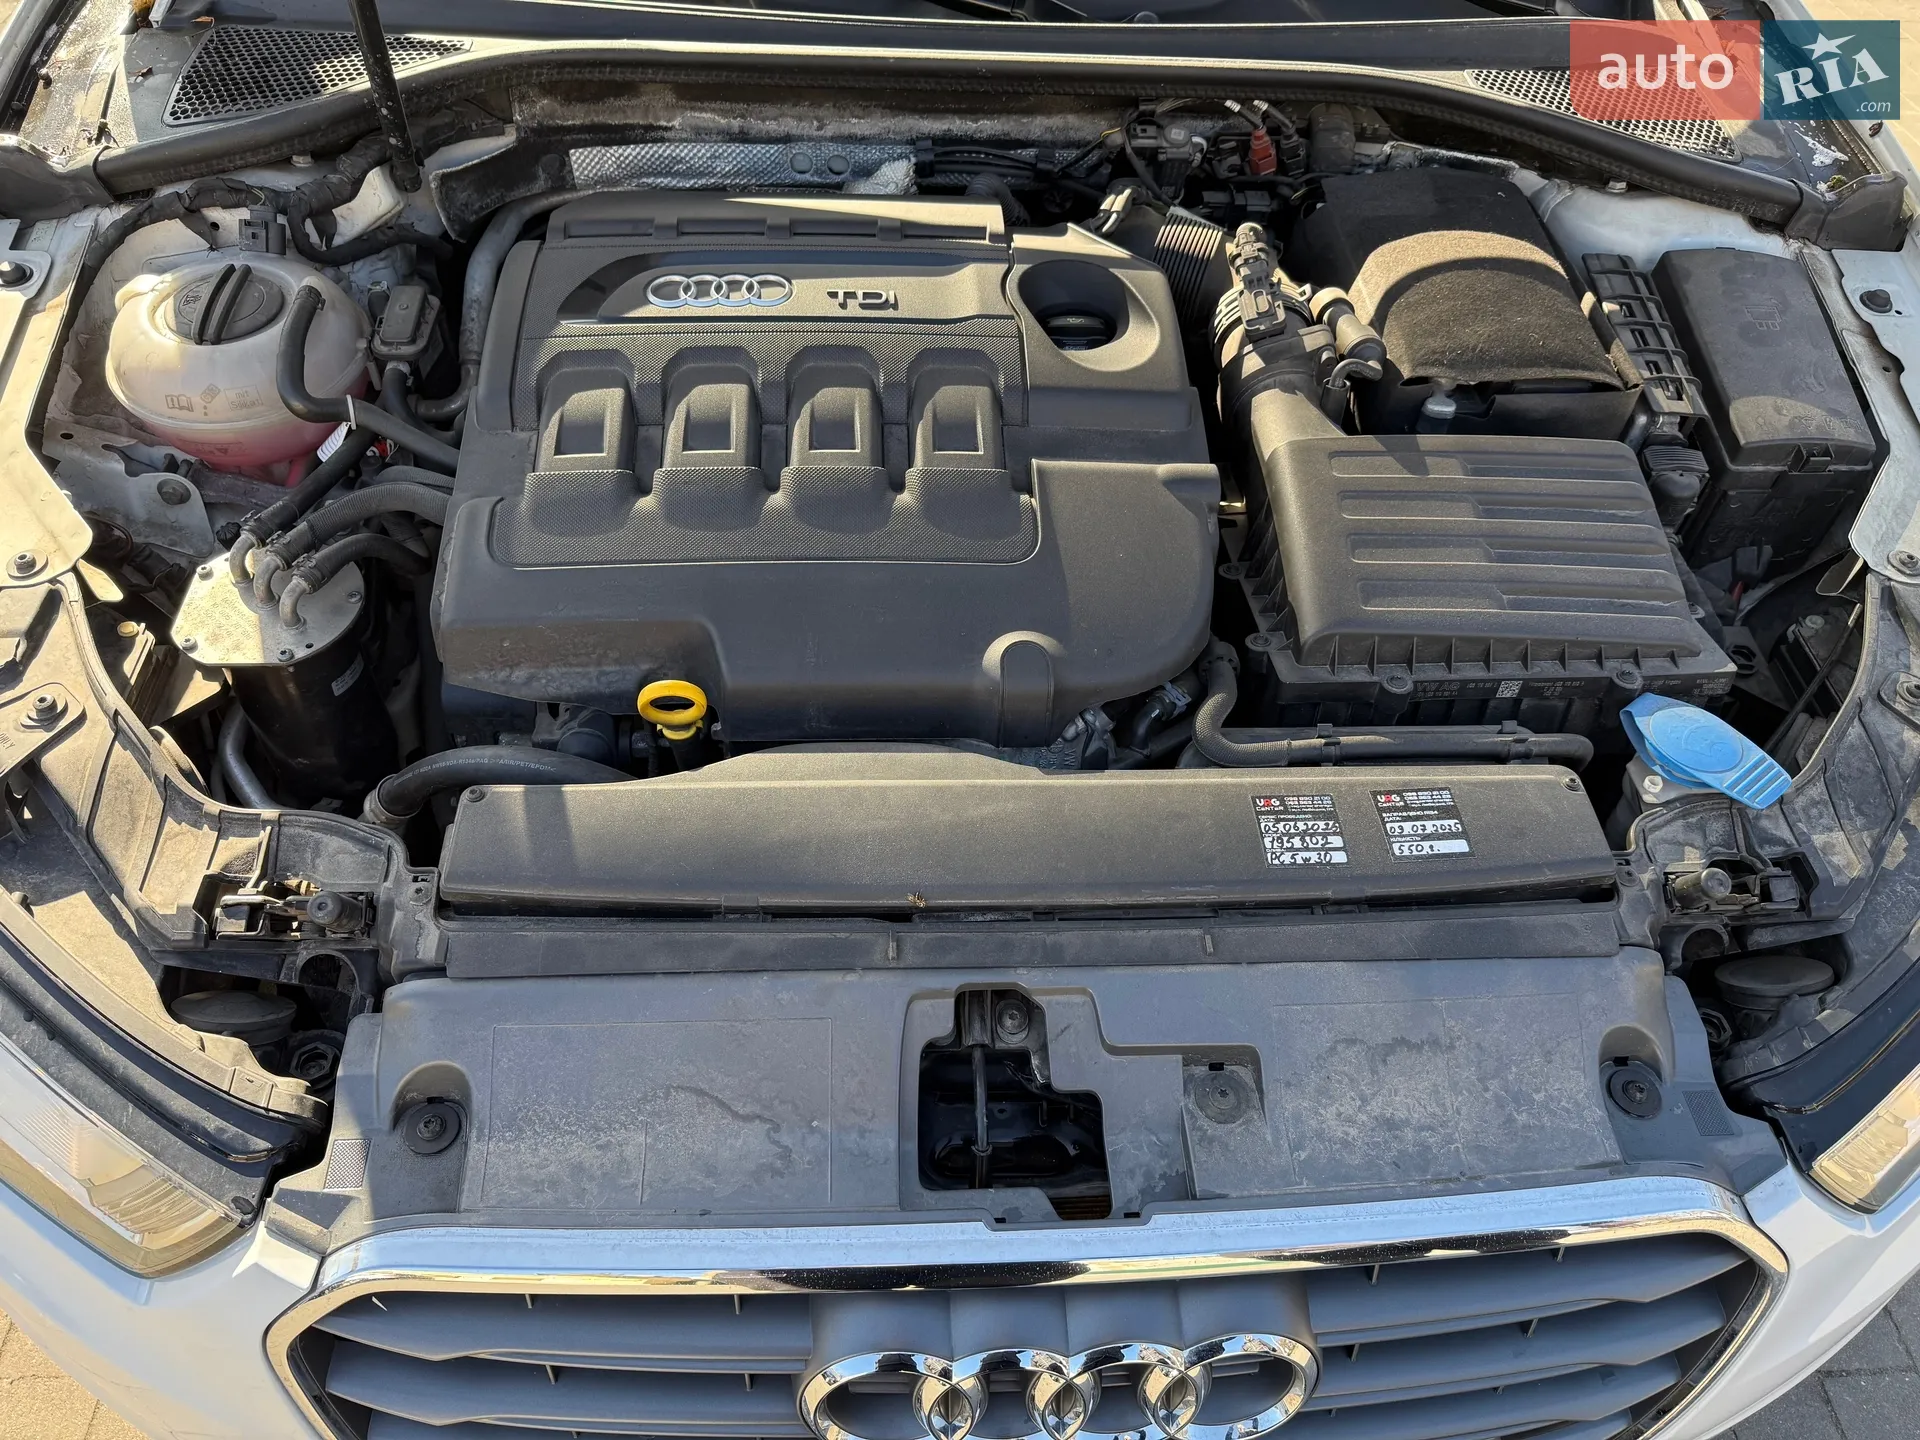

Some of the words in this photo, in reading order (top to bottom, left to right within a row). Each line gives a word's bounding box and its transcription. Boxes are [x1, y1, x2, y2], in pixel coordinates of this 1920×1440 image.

[826, 289, 899, 311] TDI
[235, 390, 249, 399] mit
[1416, 682, 1439, 692] VW
[1439, 681, 1461, 691] AG
